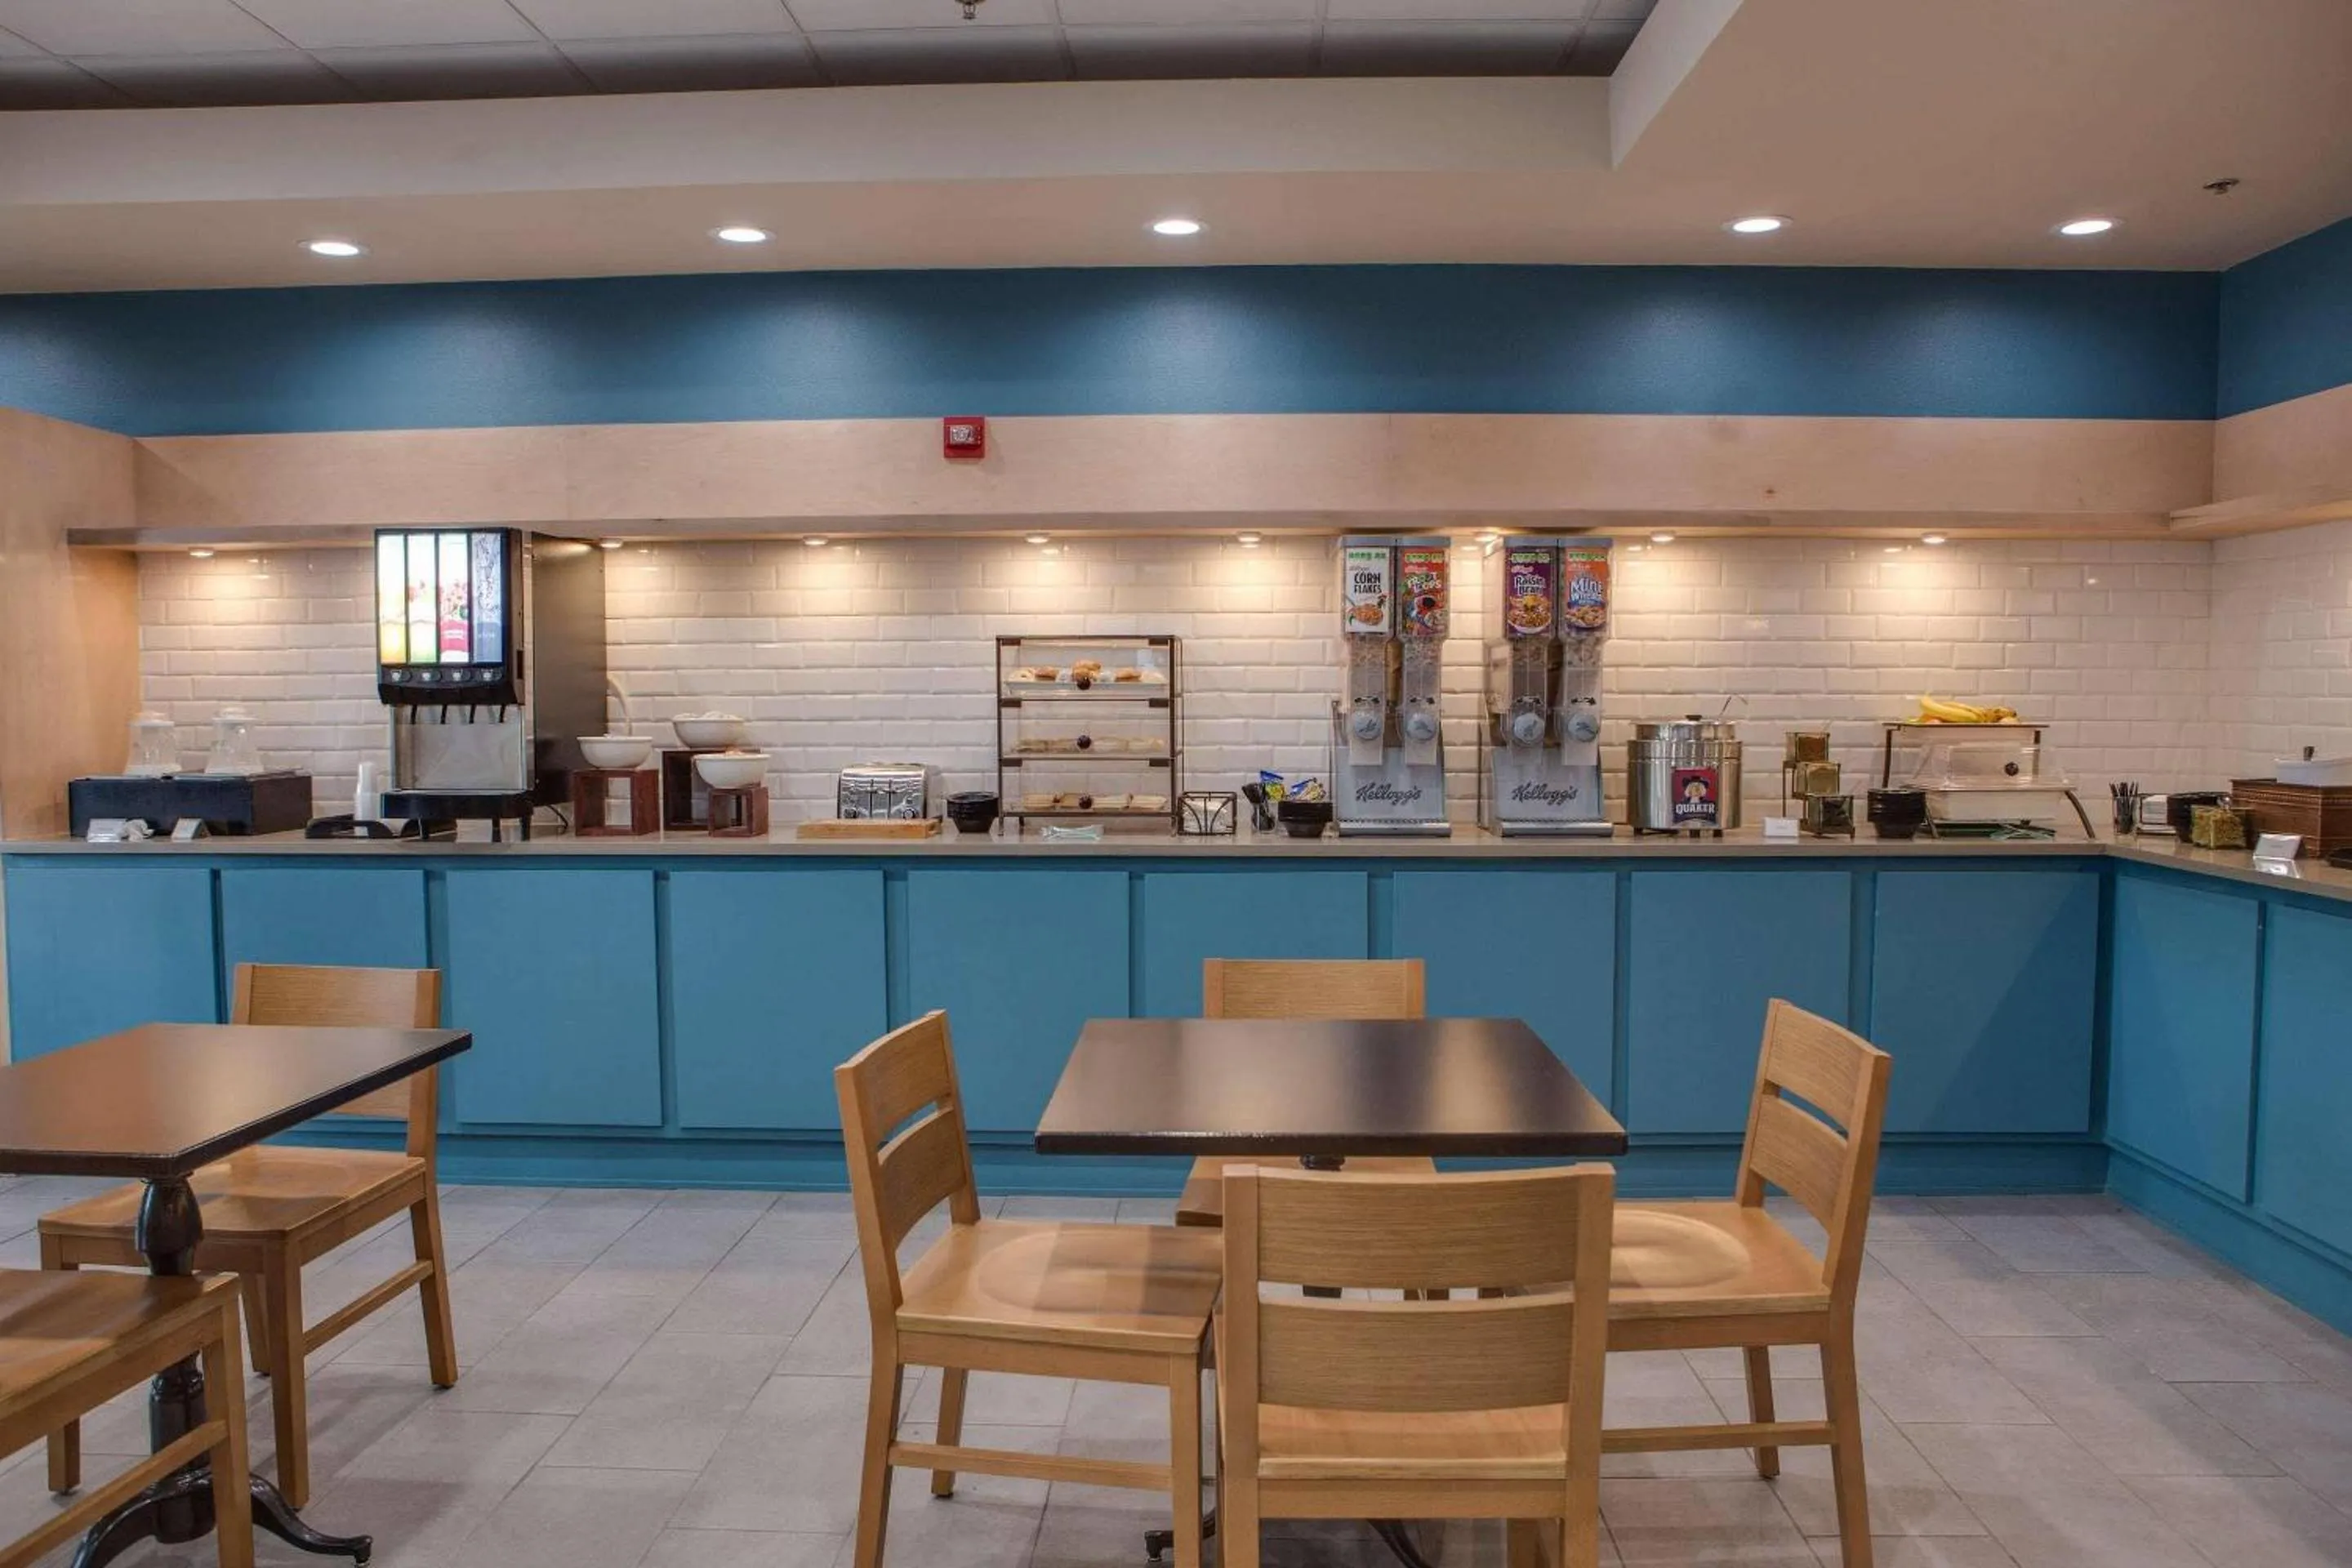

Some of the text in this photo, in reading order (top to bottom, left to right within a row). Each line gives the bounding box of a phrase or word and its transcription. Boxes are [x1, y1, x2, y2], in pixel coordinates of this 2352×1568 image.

[1354, 572, 1381, 584] CORN
[1354, 584, 1382, 594] FLAKES
[1356, 782, 1422, 806] Kellogg's
[1512, 782, 1578, 806] Kellogg's
[1676, 803, 1715, 815] QUAKER
